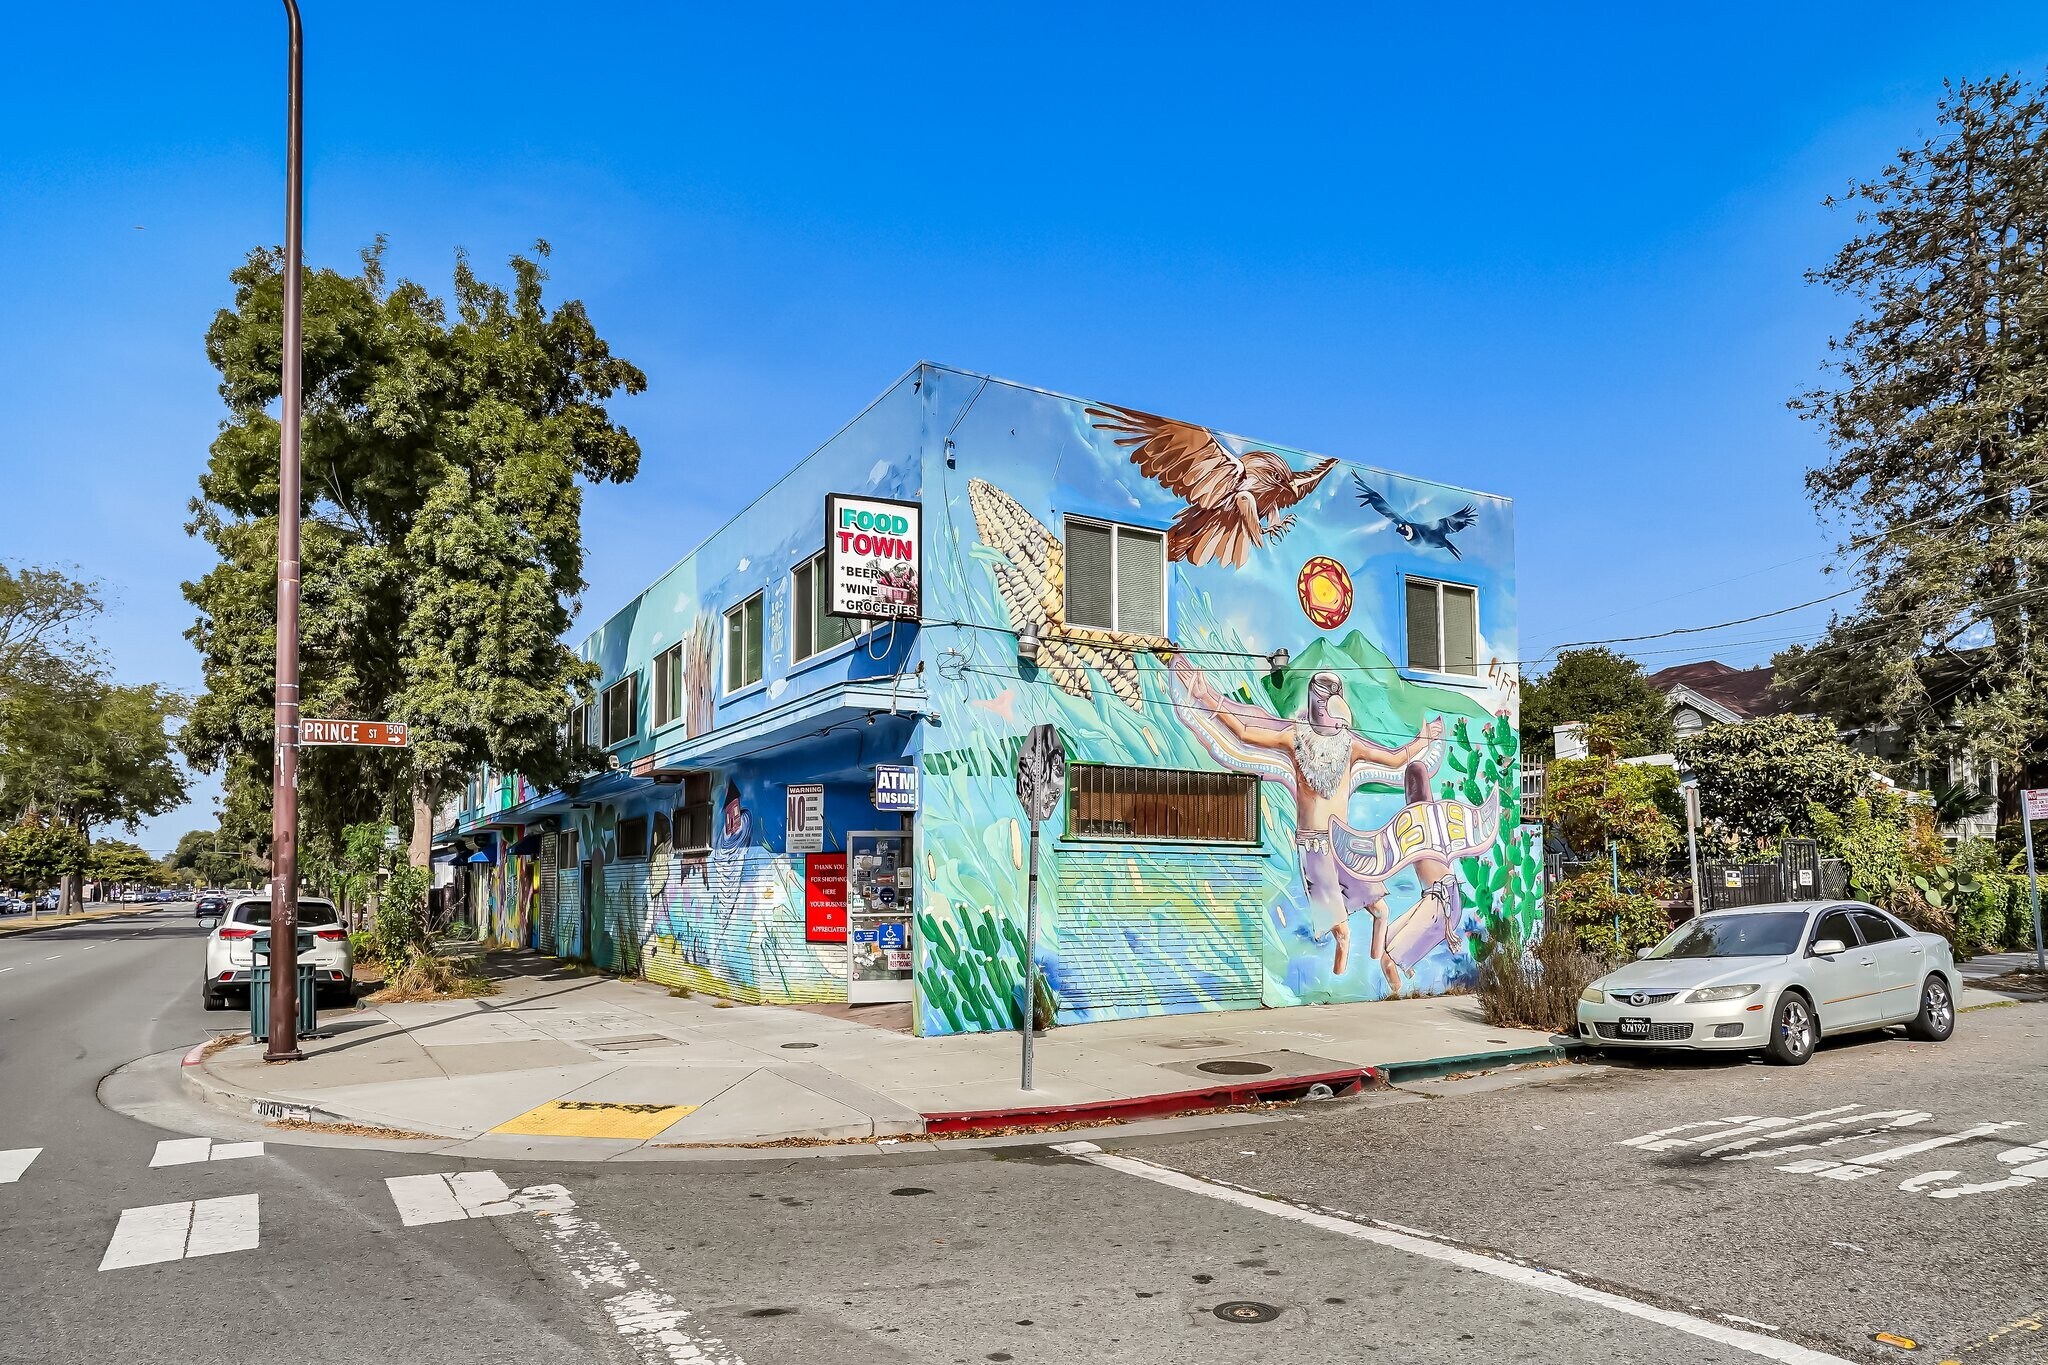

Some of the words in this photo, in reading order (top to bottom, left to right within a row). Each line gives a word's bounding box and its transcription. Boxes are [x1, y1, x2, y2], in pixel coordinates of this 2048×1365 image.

[839, 507, 909, 536] FOOD
[836, 530, 913, 562] TOWN
[304, 722, 360, 742] PRINCE
[368, 729, 378, 739] ST
[386, 725, 404, 735] 1500
[789, 786, 822, 794] WARNING
[878, 771, 915, 790] ATM
[878, 792, 915, 804] INSIDE
[788, 795, 806, 832] NO
[890, 960, 912, 968] RESTROOMS
